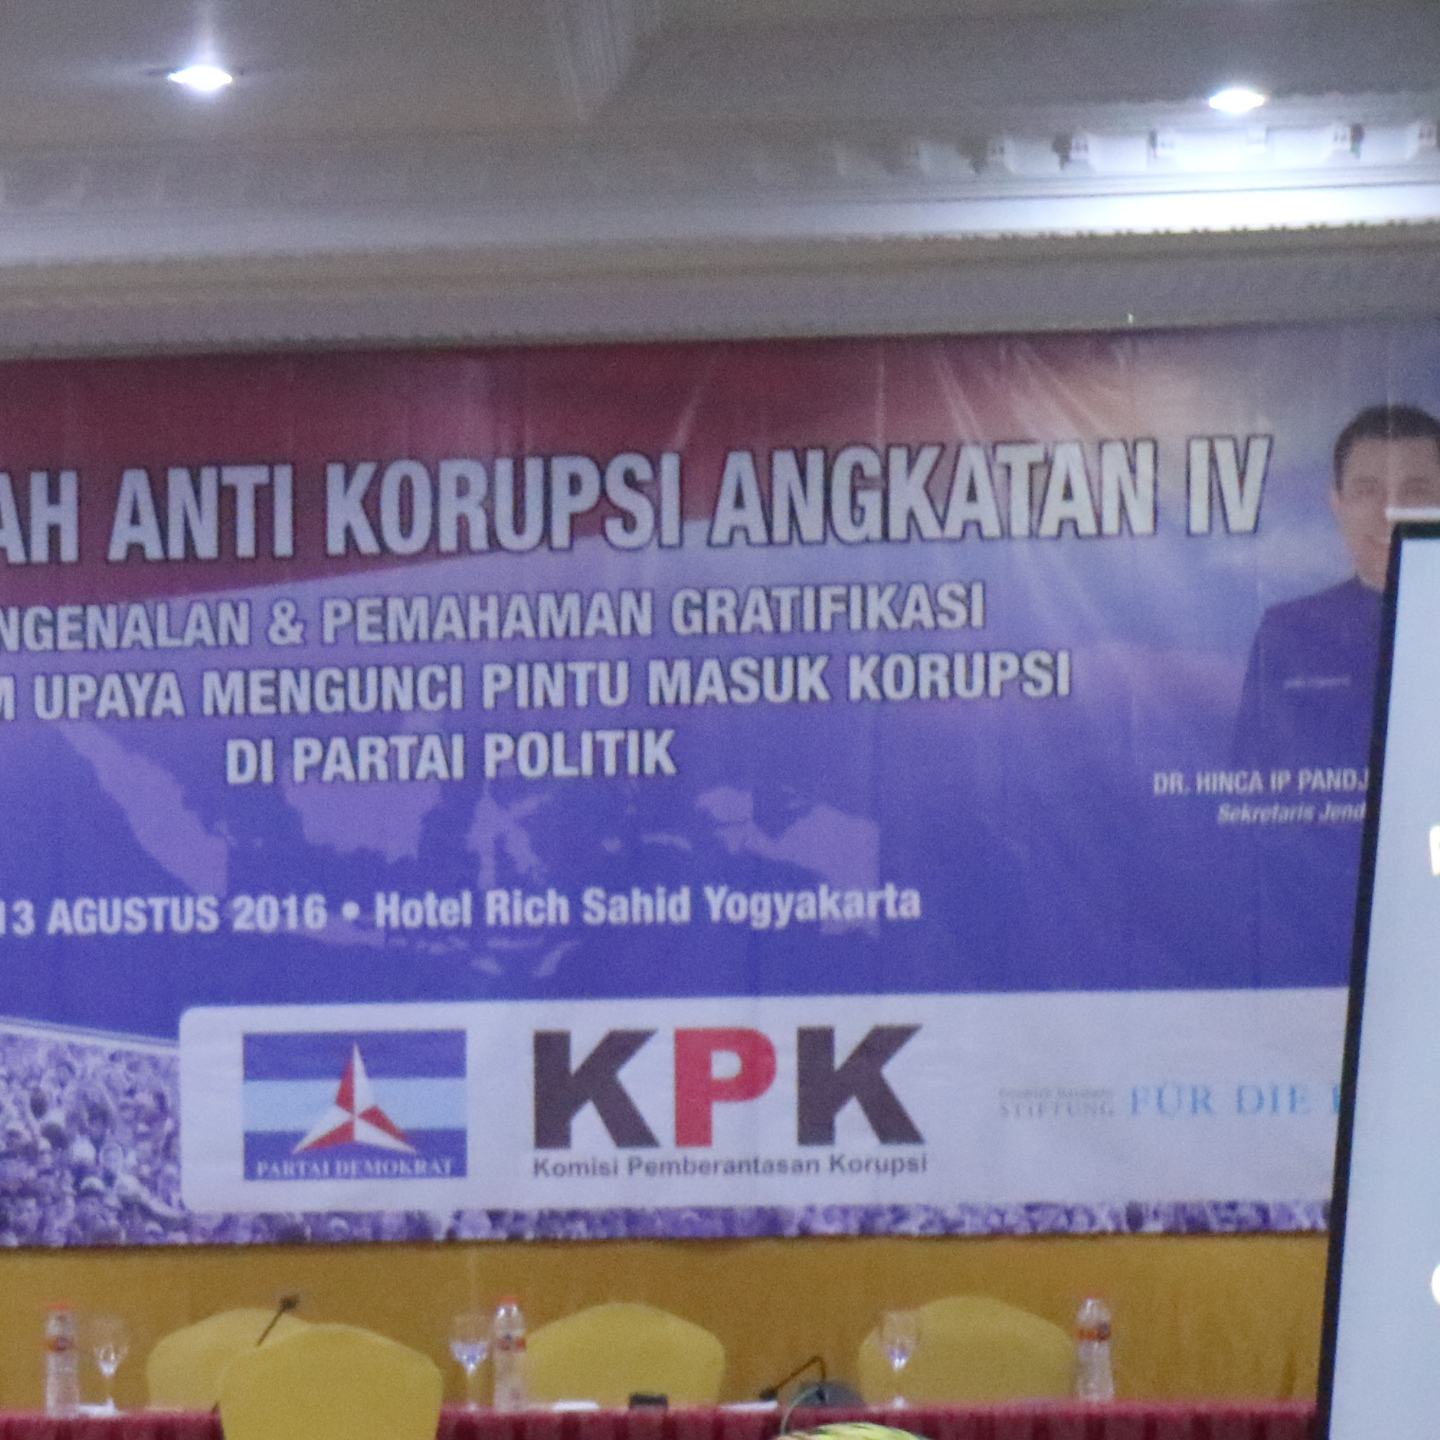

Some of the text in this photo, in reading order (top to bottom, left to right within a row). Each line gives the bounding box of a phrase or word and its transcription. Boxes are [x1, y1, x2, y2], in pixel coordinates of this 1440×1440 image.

[107, 464, 292, 562] ANTI
[325, 454, 680, 558] KORUPSI
[708, 440, 1155, 548] ANGKATAN
[1187, 436, 1273, 535] IV
[268, 605, 303, 645] &
[321, 592, 652, 645] PEMAHAMAN
[672, 583, 984, 634] GRATIFIKASI
[34, 671, 184, 721] UPAYA
[202, 665, 462, 716] MENGUNCI
[482, 659, 629, 708] PINTU
[649, 654, 830, 705] MASUK
[849, 651, 1071, 700] KORUPSI
[225, 730, 676, 784] DI PARTAI POLITIK
[1153, 772, 1190, 795] DR.
[1196, 770, 1263, 794] HINCA
[1298, 768, 1369, 791] PANDJ
[1218, 802, 1366, 825] Sekretaris Jend
[47, 896, 219, 934] AGUSTUS
[232, 894, 327, 932] 2016
[374, 891, 472, 930] Hotel
[486, 887, 568, 926] Rich
[582, 886, 691, 925] Sahid
[705, 883, 921, 930] Yogyakarta
[532, 1025, 926, 1150] KPK
[1236, 1084, 1311, 1115] DIE
[257, 1158, 453, 1177] PARTAI DEMOKRAT
[532, 1153, 928, 1179] Komisi Pemberantasan Korupsi
